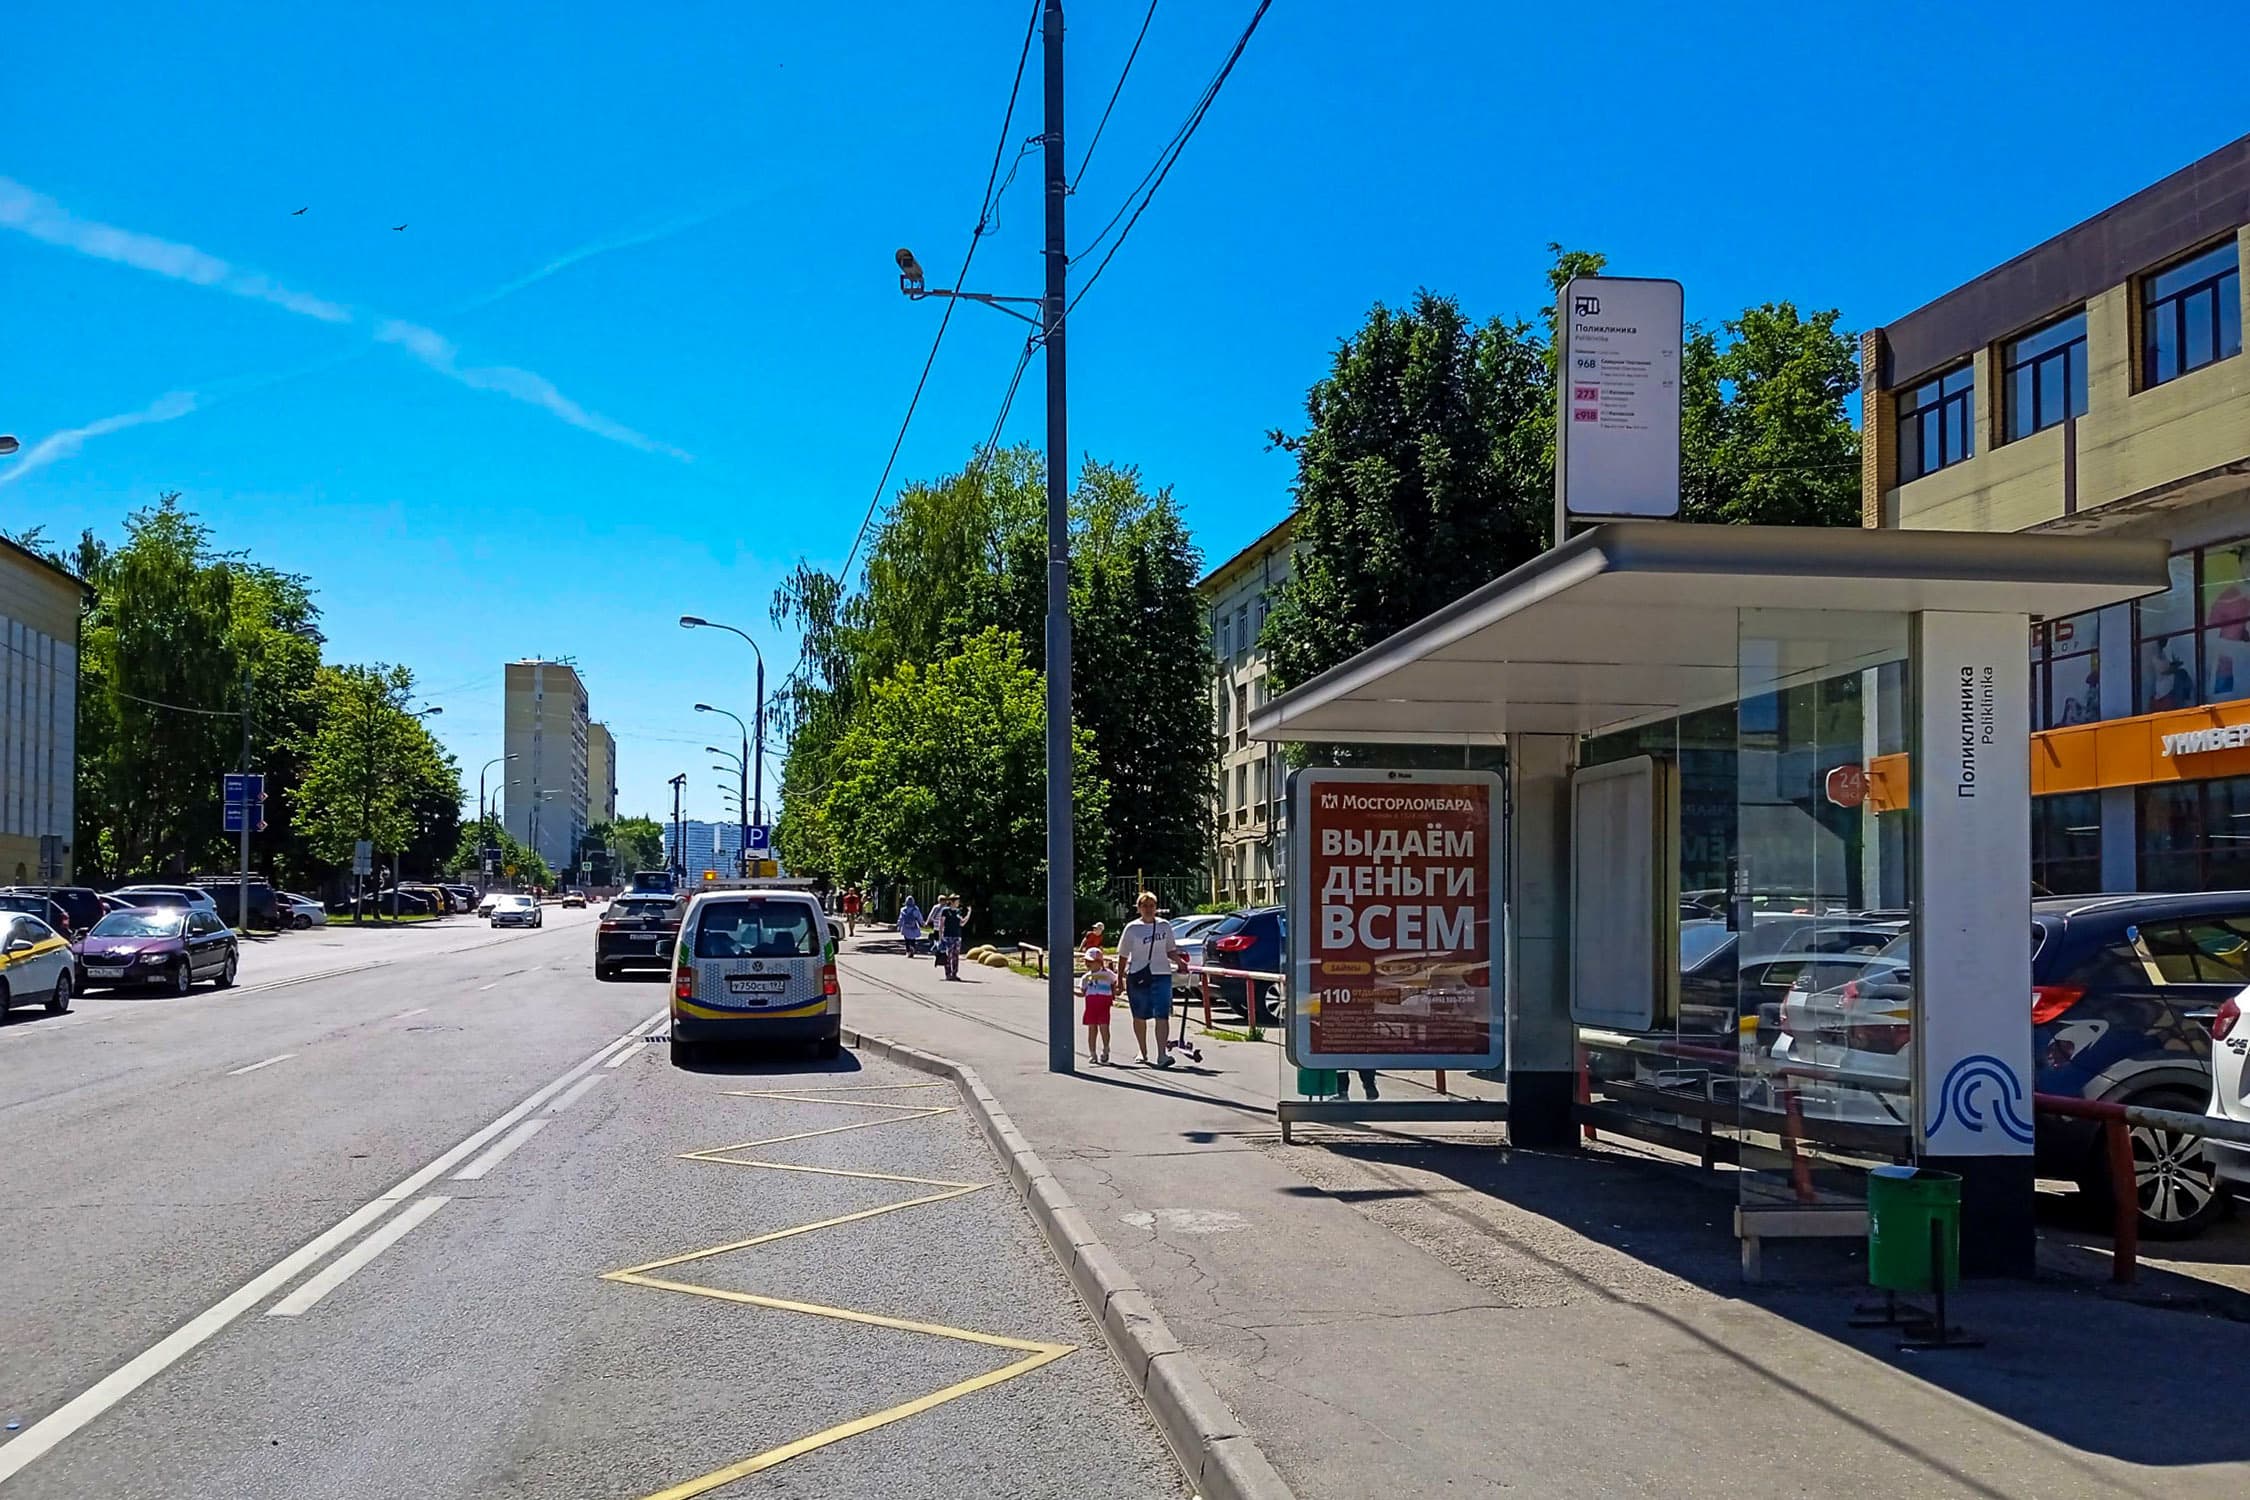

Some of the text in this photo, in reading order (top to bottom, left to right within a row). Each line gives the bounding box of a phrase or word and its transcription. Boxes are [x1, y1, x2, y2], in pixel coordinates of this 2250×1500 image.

[1575, 323, 1637, 334] Поликлиника
[1577, 359, 1597, 369] 968
[1576, 389, 1596, 400] 273
[1980, 666, 1994, 745] Poliklinika
[1958, 665, 1975, 798] Поликлиника
[750, 828, 763, 846] P
[1321, 822, 1474, 864] ВЫДАЁМ
[1321, 866, 1475, 905] ДЕНЬГИ
[1321, 904, 1475, 950] ВСЕМ
[1323, 988, 1351, 1004] 110
